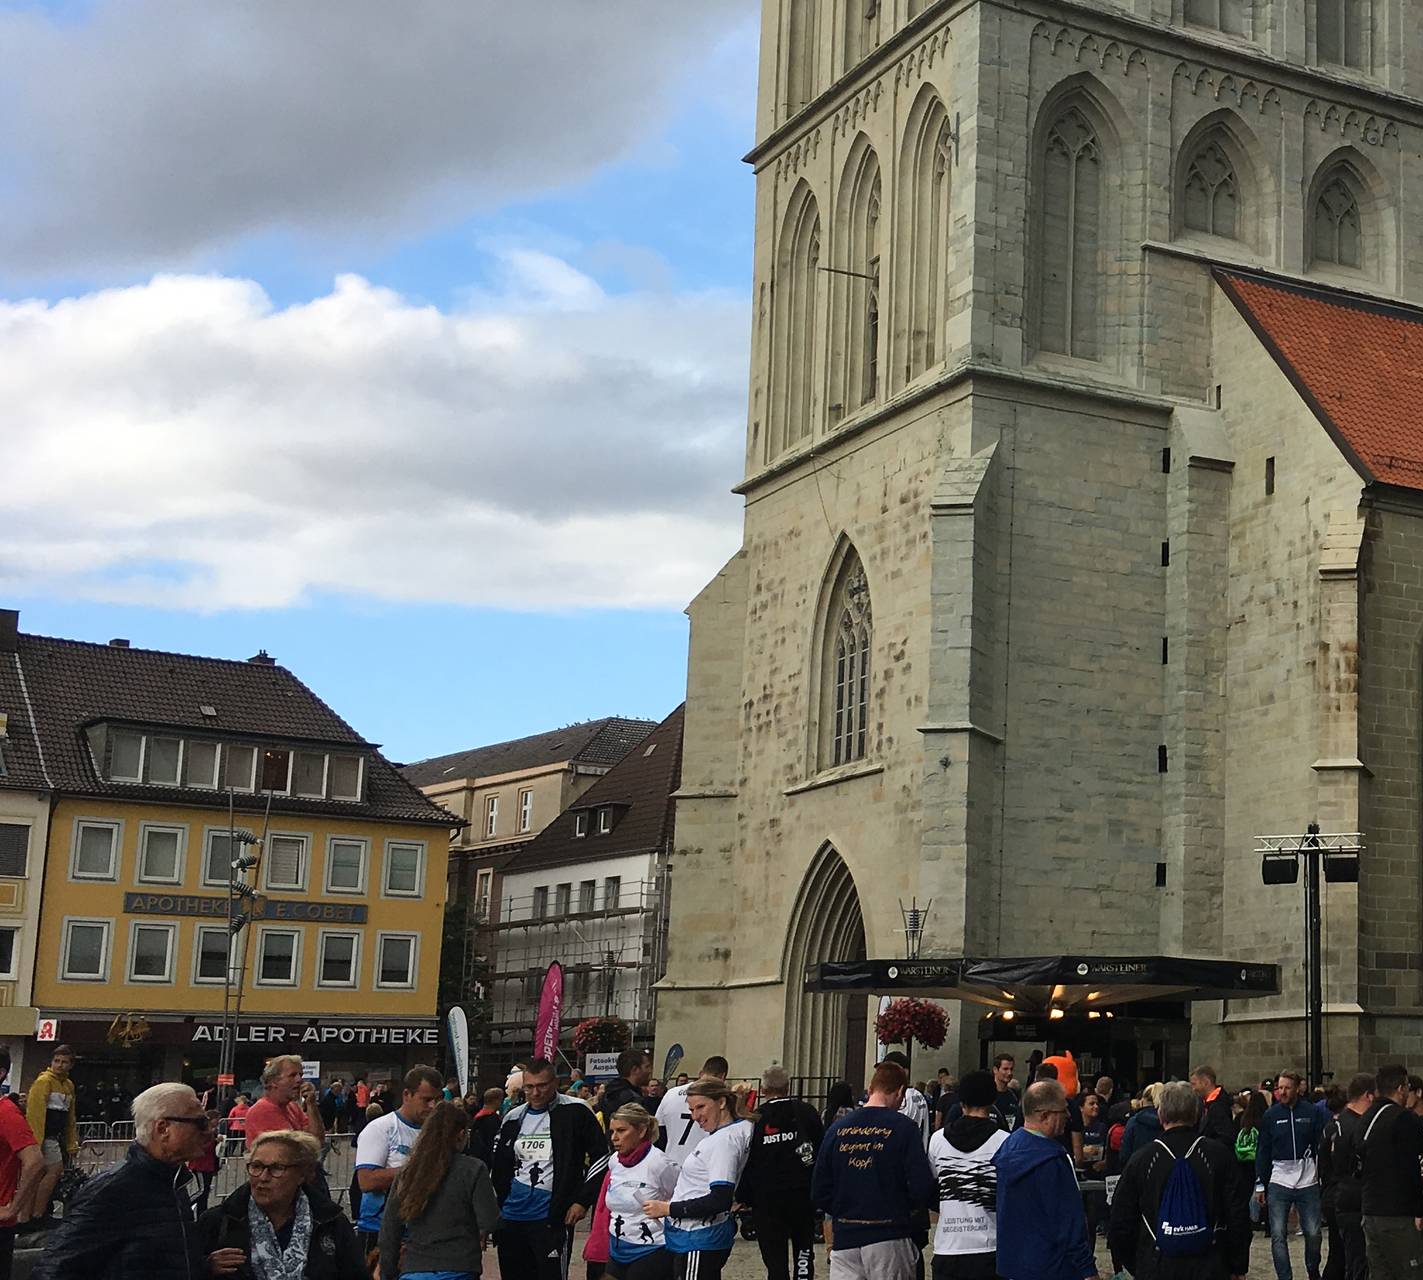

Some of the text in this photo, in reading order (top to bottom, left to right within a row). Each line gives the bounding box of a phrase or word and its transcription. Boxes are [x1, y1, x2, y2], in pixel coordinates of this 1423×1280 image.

[192, 1025, 440, 1044] ADLER-APOTHEKE
[520, 1140, 546, 1150] 1706
[763, 1133, 780, 1145] JUST
[782, 1131, 794, 1142] DO
[798, 1259, 809, 1275] DO
